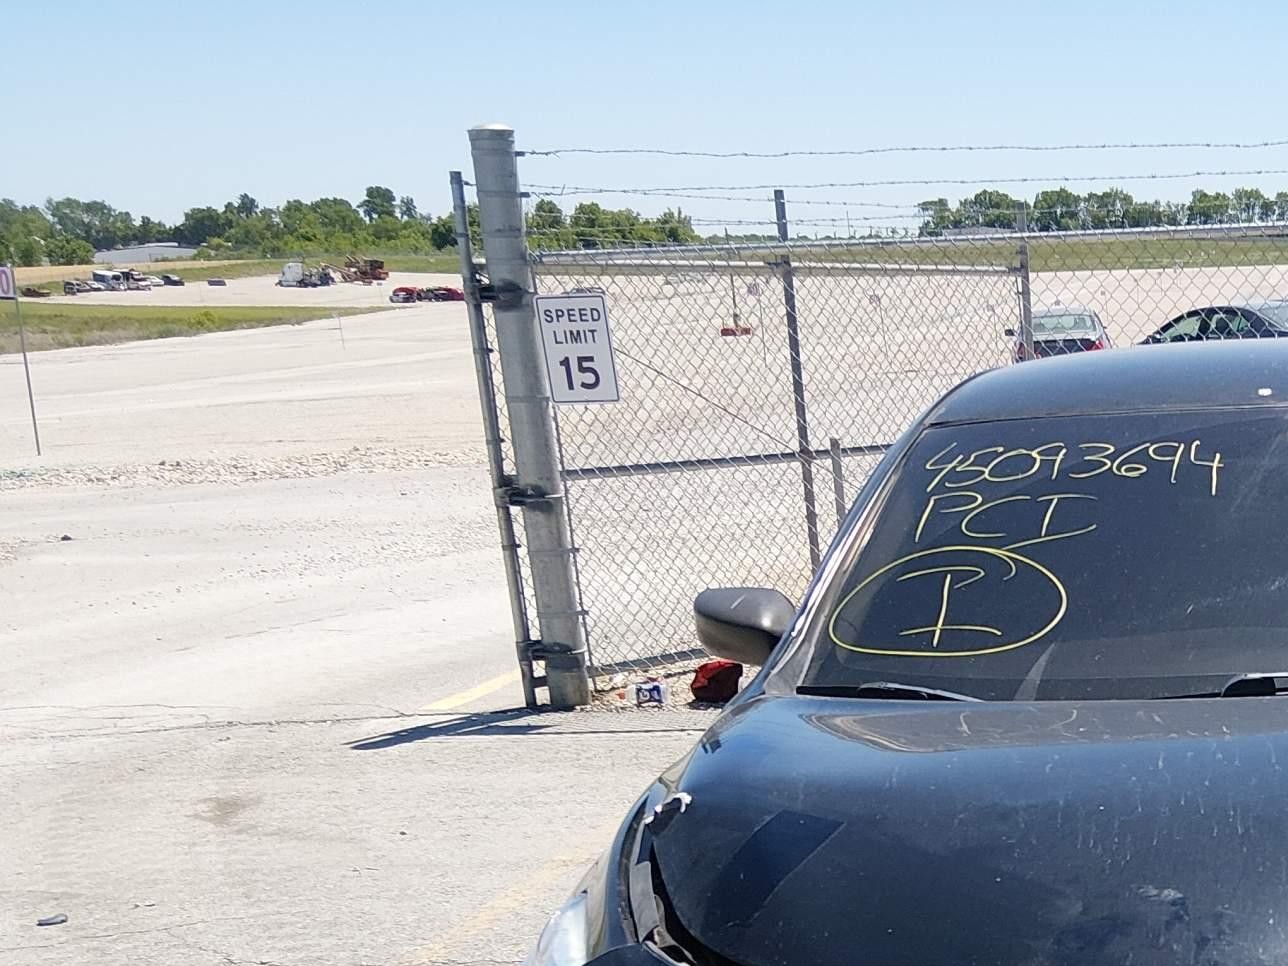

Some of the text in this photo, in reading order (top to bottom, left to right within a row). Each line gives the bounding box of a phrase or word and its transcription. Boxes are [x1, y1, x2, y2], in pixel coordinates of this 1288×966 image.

[544, 308, 601, 323] SPEED
[553, 329, 598, 345] LIMIT
[559, 356, 601, 391] 15
[926, 440, 1225, 497] 45093694
